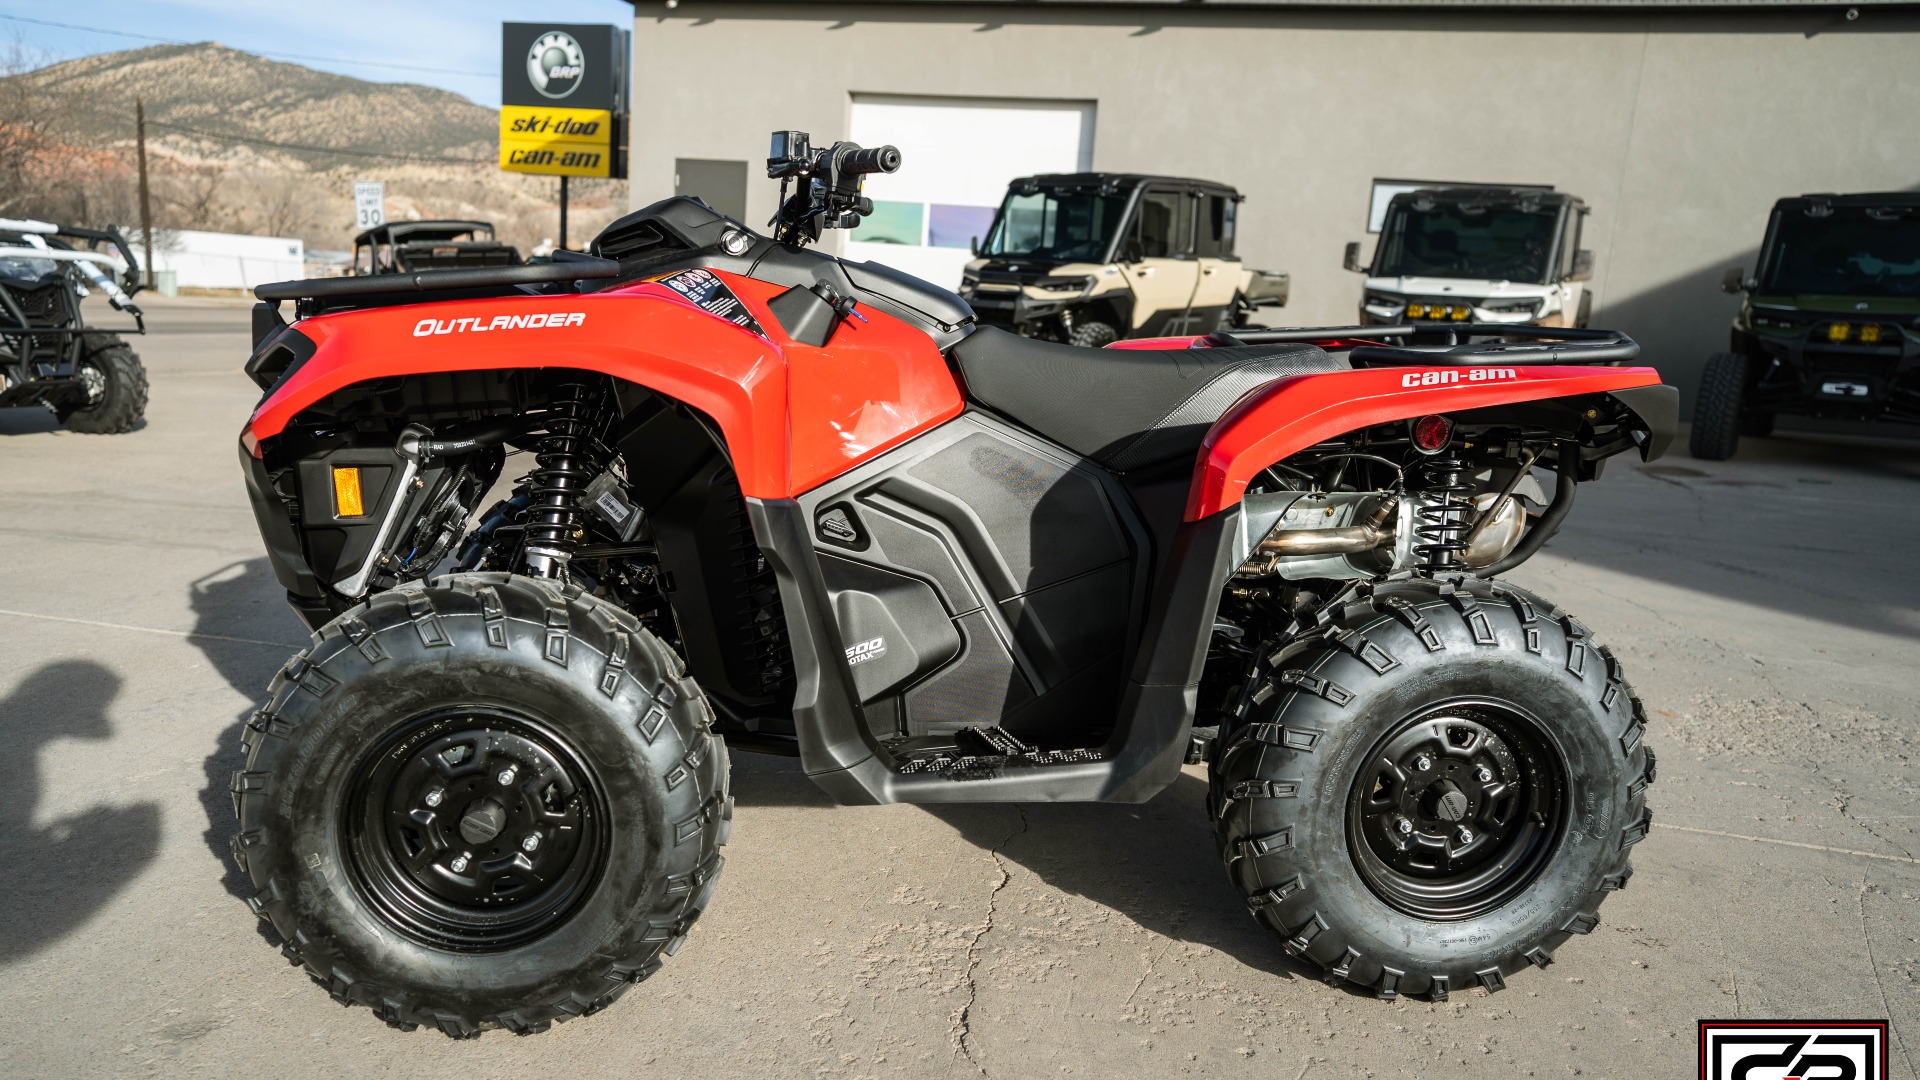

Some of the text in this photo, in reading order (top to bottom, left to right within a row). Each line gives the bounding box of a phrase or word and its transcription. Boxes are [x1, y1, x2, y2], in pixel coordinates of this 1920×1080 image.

[510, 114, 600, 136] ski-doo
[509, 149, 601, 168] can-am
[360, 209, 380, 225] 30
[413, 312, 587, 337] OUTLANDER
[1401, 368, 1517, 388] can-am
[845, 638, 883, 658] 500
